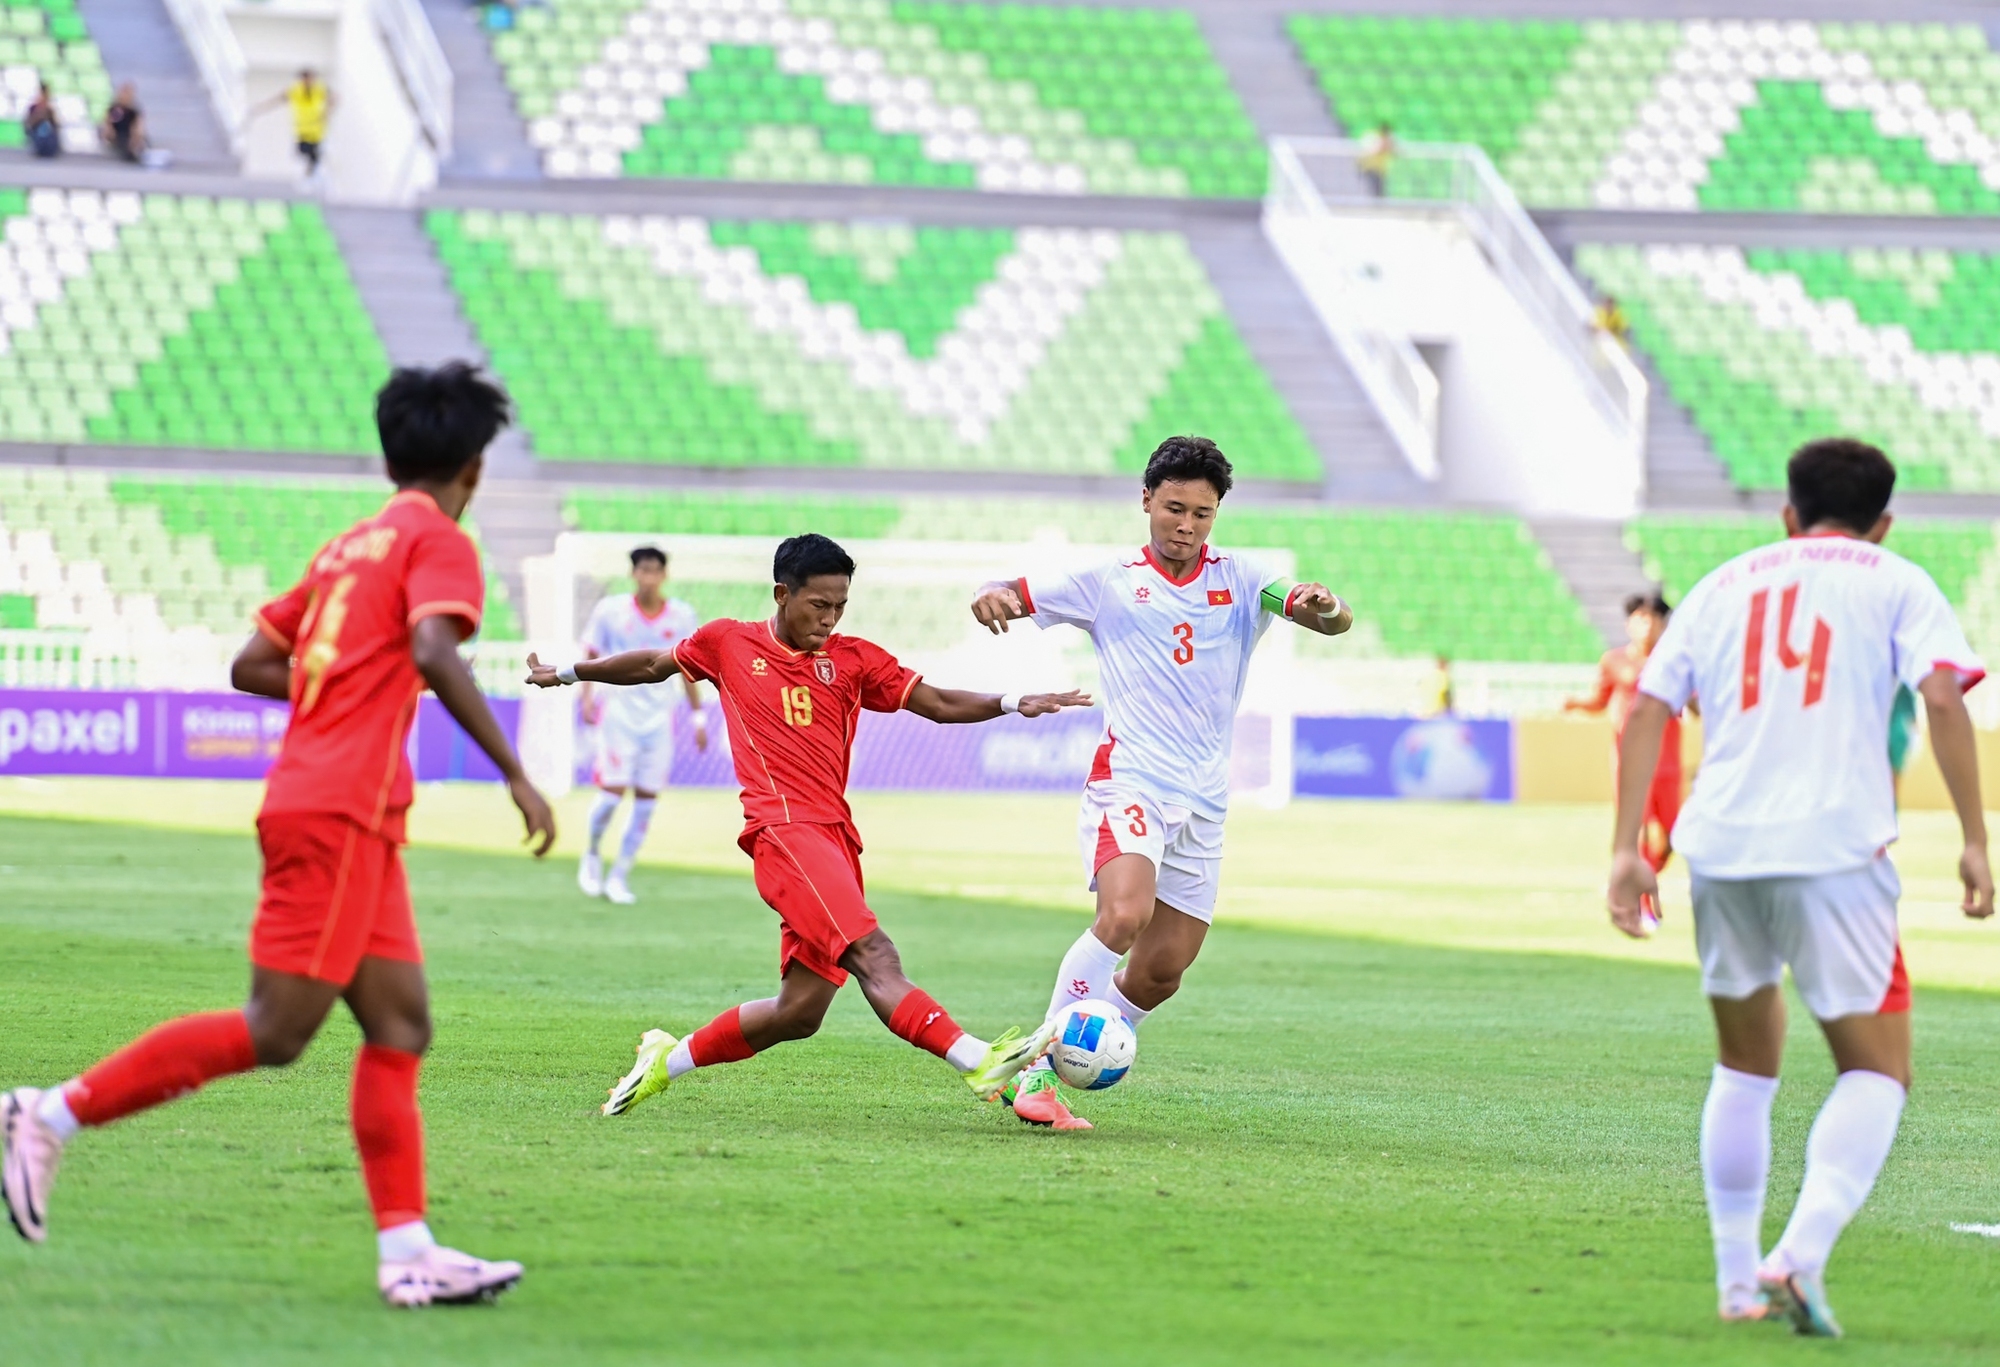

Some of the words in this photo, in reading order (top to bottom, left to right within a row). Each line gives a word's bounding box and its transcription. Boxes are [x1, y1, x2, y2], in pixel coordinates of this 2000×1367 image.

[1172, 621, 1194, 666] 3
[1741, 580, 1832, 712] 14
[780, 685, 813, 727] 19
[0, 698, 139, 766] paxel
[1123, 803, 1147, 837] 3
[1063, 1057, 1089, 1068] molten
